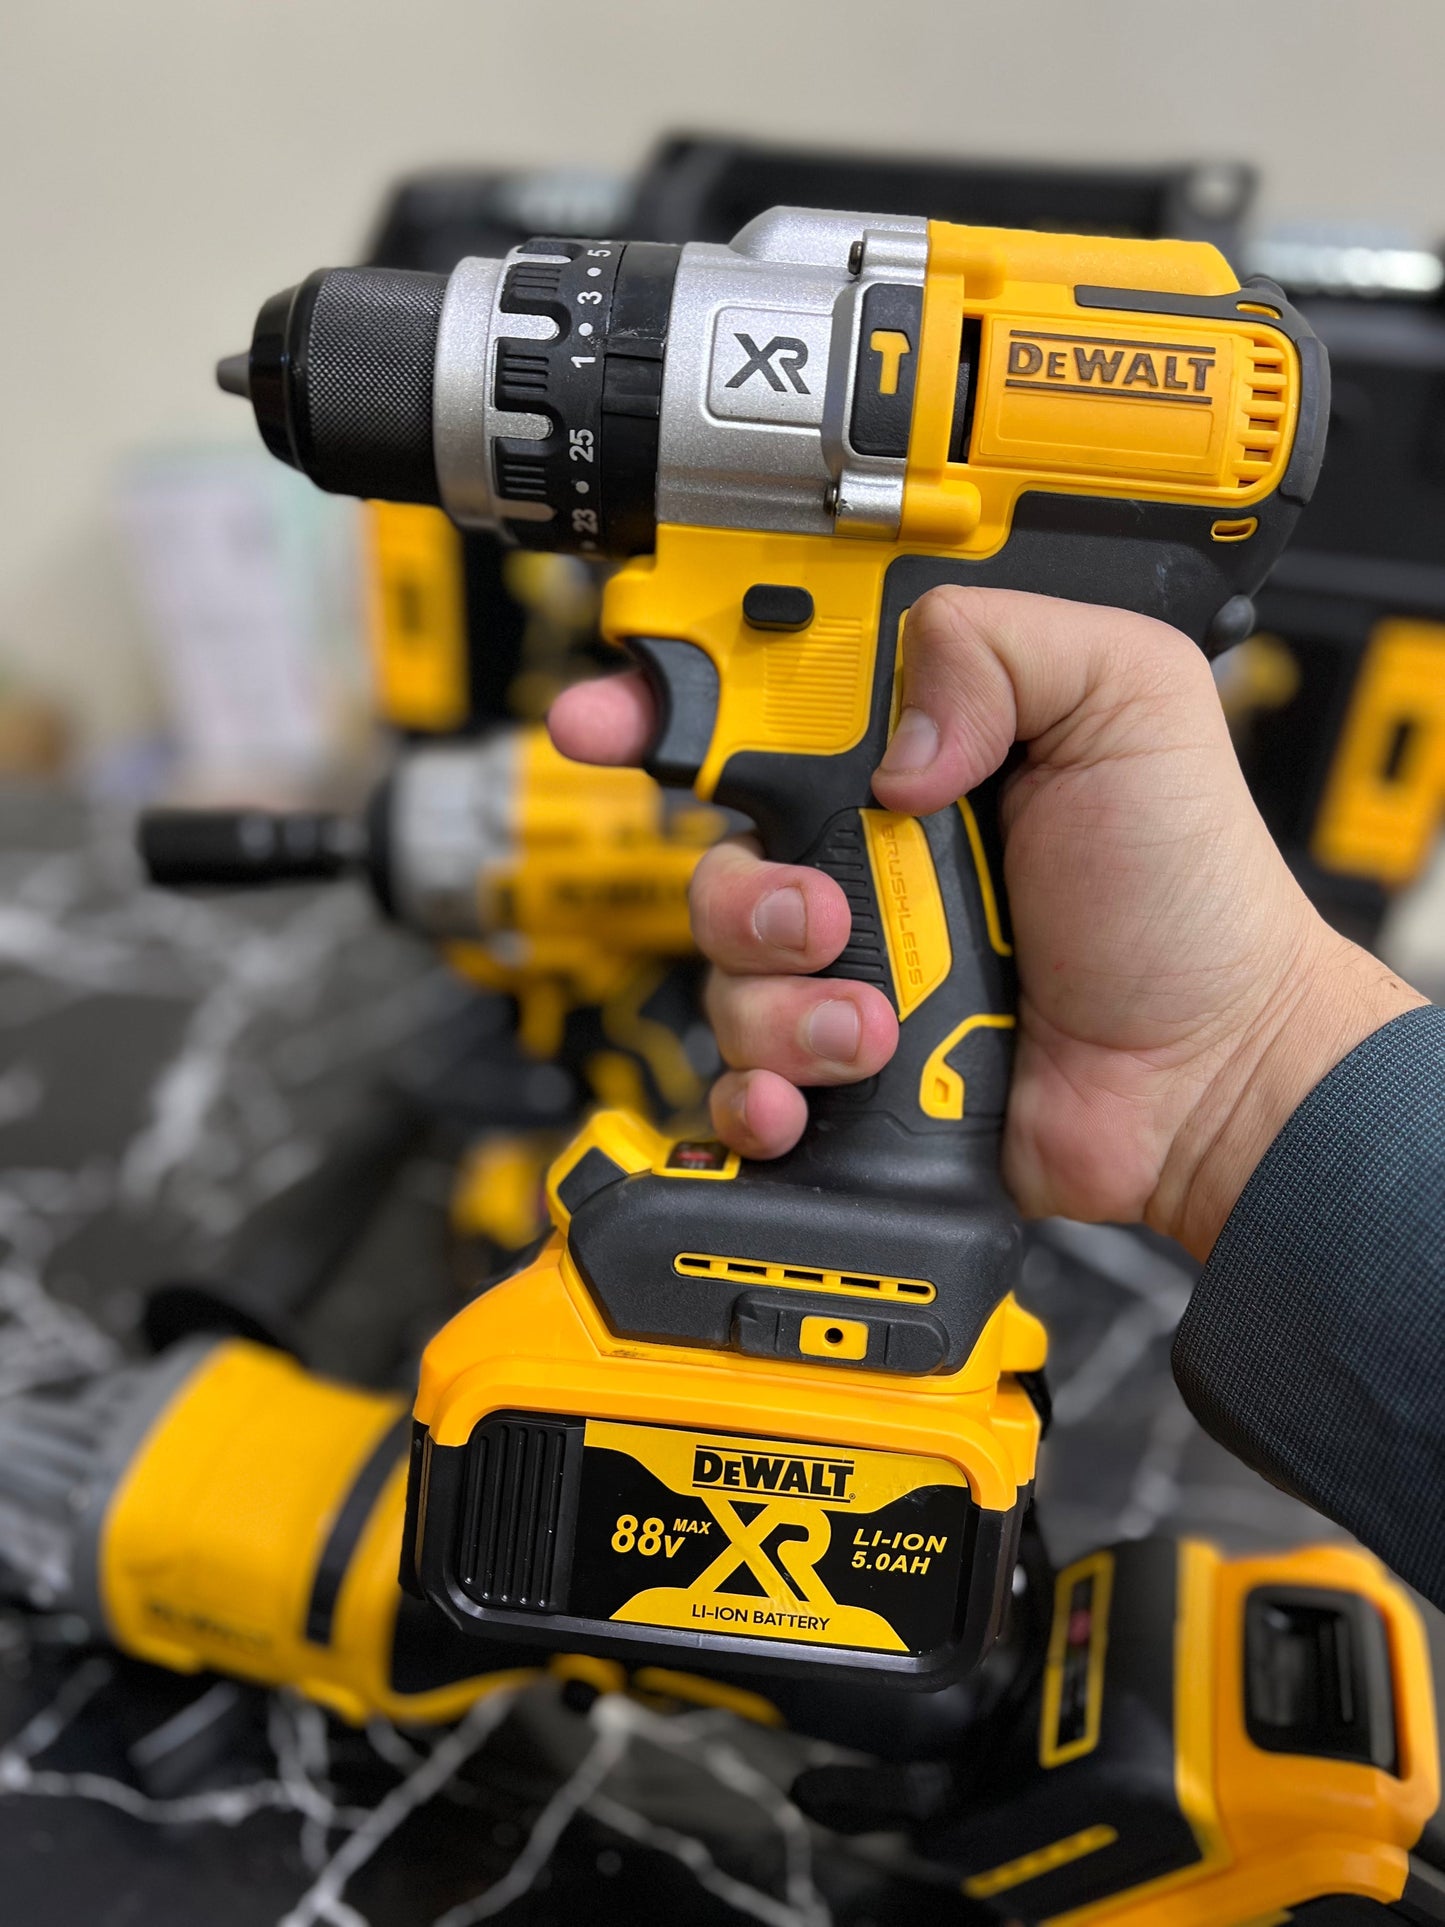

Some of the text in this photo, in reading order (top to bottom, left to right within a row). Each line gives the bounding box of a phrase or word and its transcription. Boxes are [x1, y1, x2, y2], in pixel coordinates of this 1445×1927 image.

[587, 249, 612, 258] 5
[577, 290, 603, 306] 3
[571, 355, 597, 369] 1
[725, 333, 811, 394] XR
[569, 429, 594, 463] 25
[572, 508, 598, 534] 23
[881, 824, 923, 985] BRUSHLESS
[673, 1518, 712, 1535] MAX
[687, 1493, 838, 1603] XR
[853, 1528, 947, 1554] LI-ION
[851, 1551, 931, 1575] 5.0AH
[691, 1603, 831, 1632] LI-ION BATTERY
